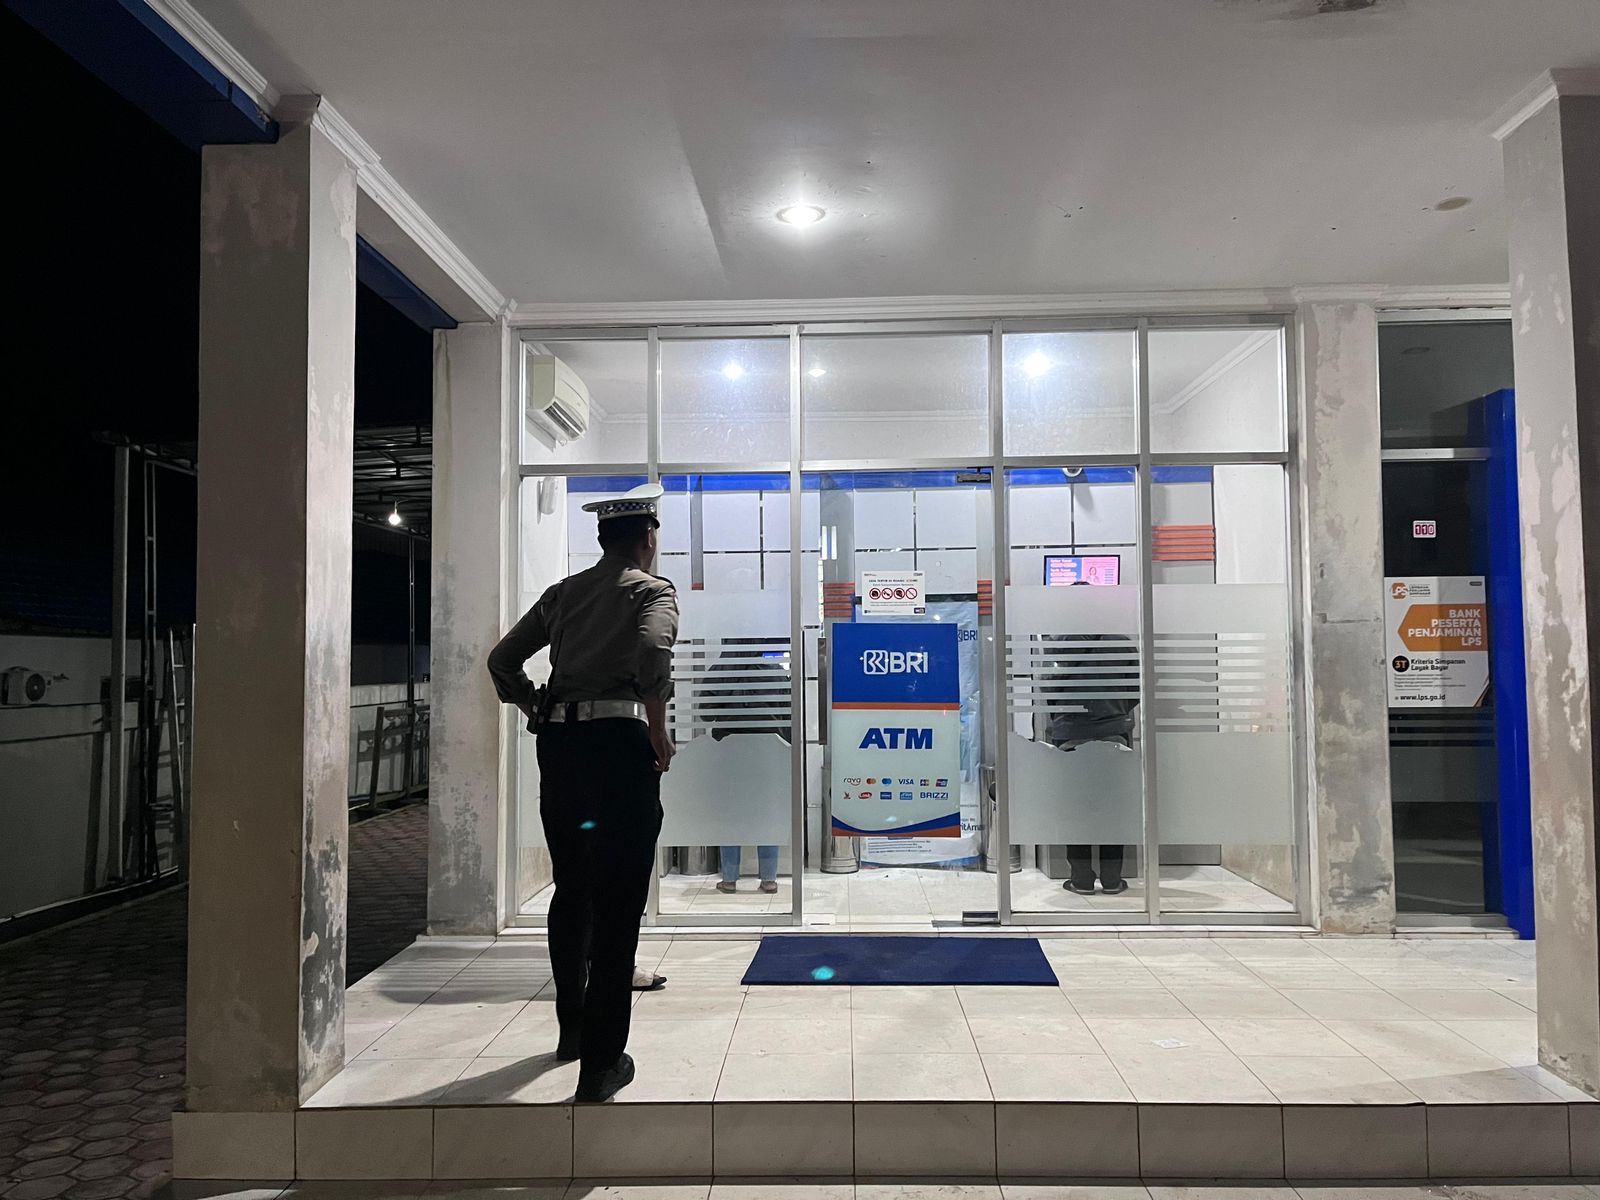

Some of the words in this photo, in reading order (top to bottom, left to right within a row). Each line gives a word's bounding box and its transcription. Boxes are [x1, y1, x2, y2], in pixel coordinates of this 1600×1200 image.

[1415, 525, 1435, 535] 110
[1449, 609, 1481, 618] BANK
[1431, 619, 1481, 628] PESERTA
[963, 630, 978, 641] BRI
[1408, 628, 1482, 637] PENJAMINAN
[1461, 637, 1482, 646] LPS
[890, 652, 929, 673] BRI
[1435, 658, 1466, 667] Simpanan
[1411, 664, 1429, 672] Layak
[1431, 664, 1449, 672] Bayar
[1400, 693, 1446, 701] www.lps.go.id
[859, 728, 933, 749] ATM
